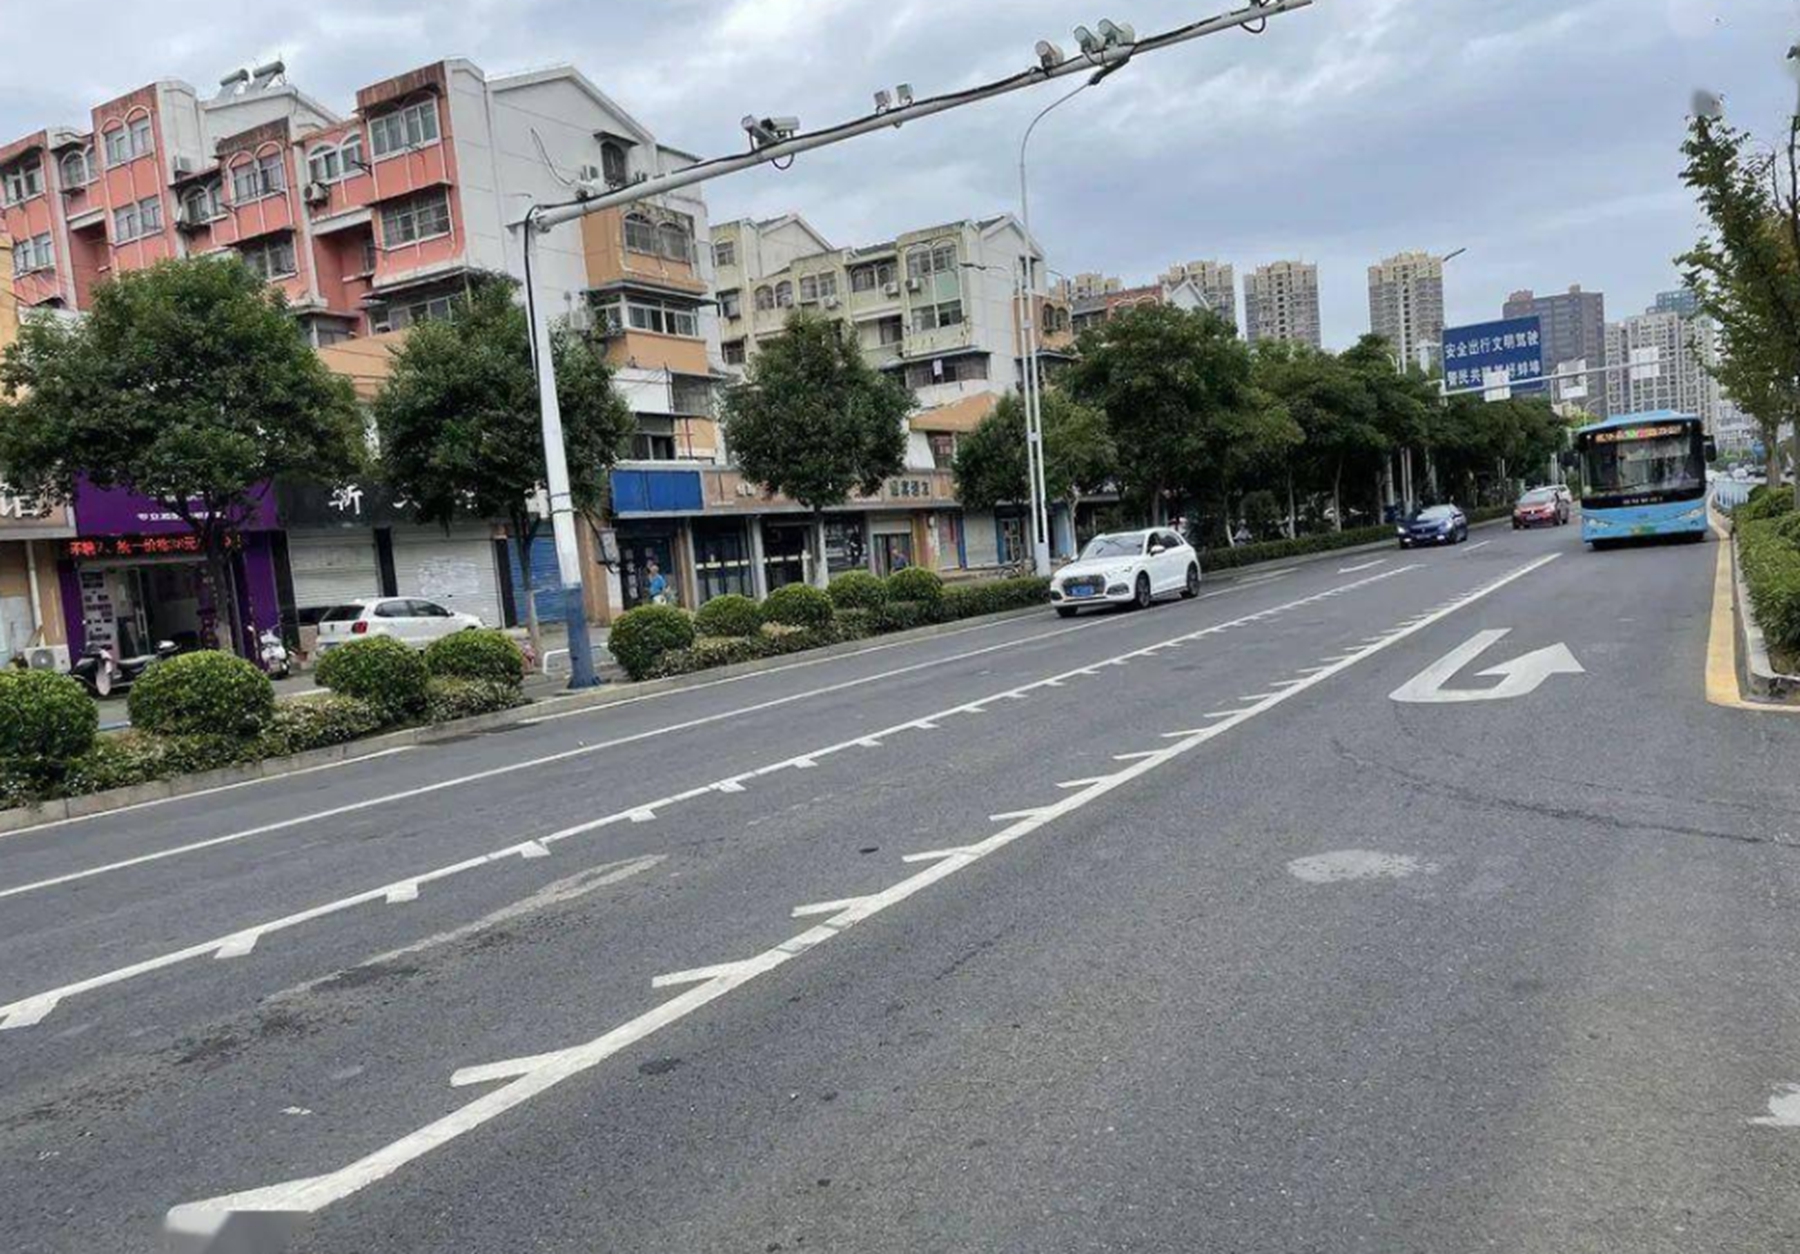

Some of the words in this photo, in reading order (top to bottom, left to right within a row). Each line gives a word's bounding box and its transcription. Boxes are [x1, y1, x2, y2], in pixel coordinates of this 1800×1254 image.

[1445, 330, 1539, 359] 安全出行文明驾驶
